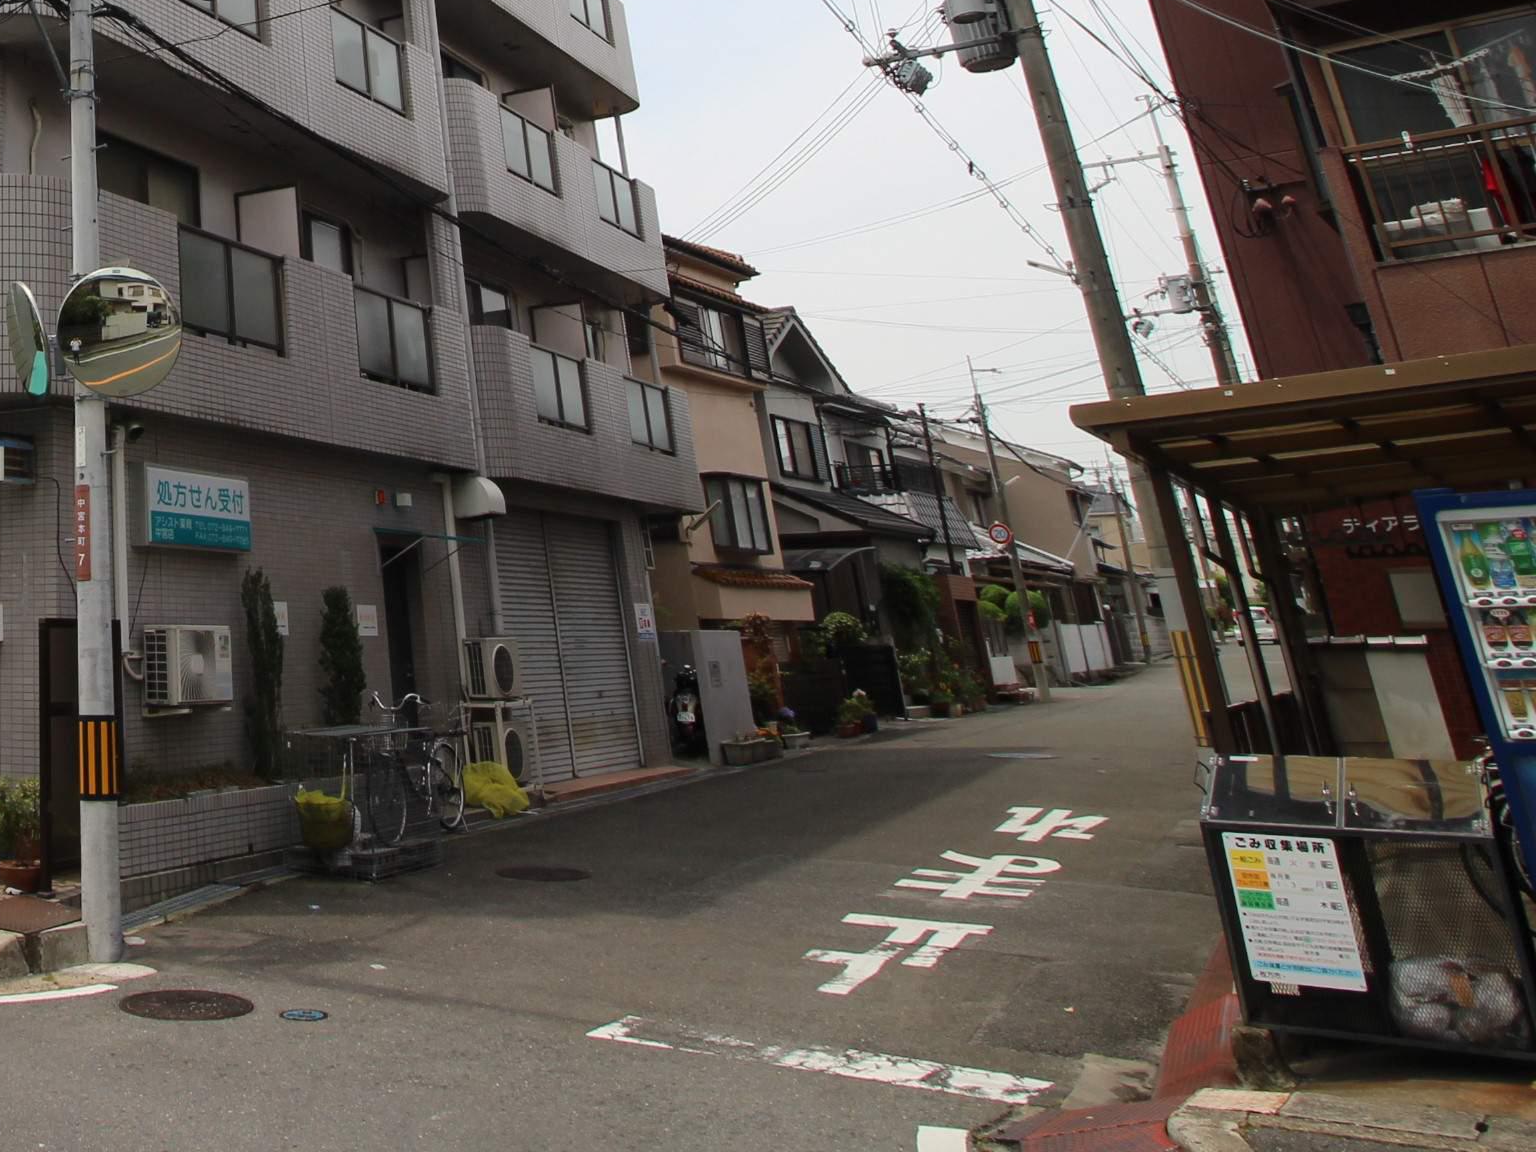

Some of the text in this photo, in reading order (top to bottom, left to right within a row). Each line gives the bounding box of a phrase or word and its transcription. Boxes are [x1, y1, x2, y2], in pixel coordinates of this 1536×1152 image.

[156, 479, 245, 515] 処方せん受付
[77, 498, 86, 567] 中宮本町 7
[993, 528, 1006, 539] 20
[1341, 515, 1421, 535] ディアラ
[1235, 837, 1325, 854] ごみ収集場所
[802, 806, 1110, 995] 止まれ
